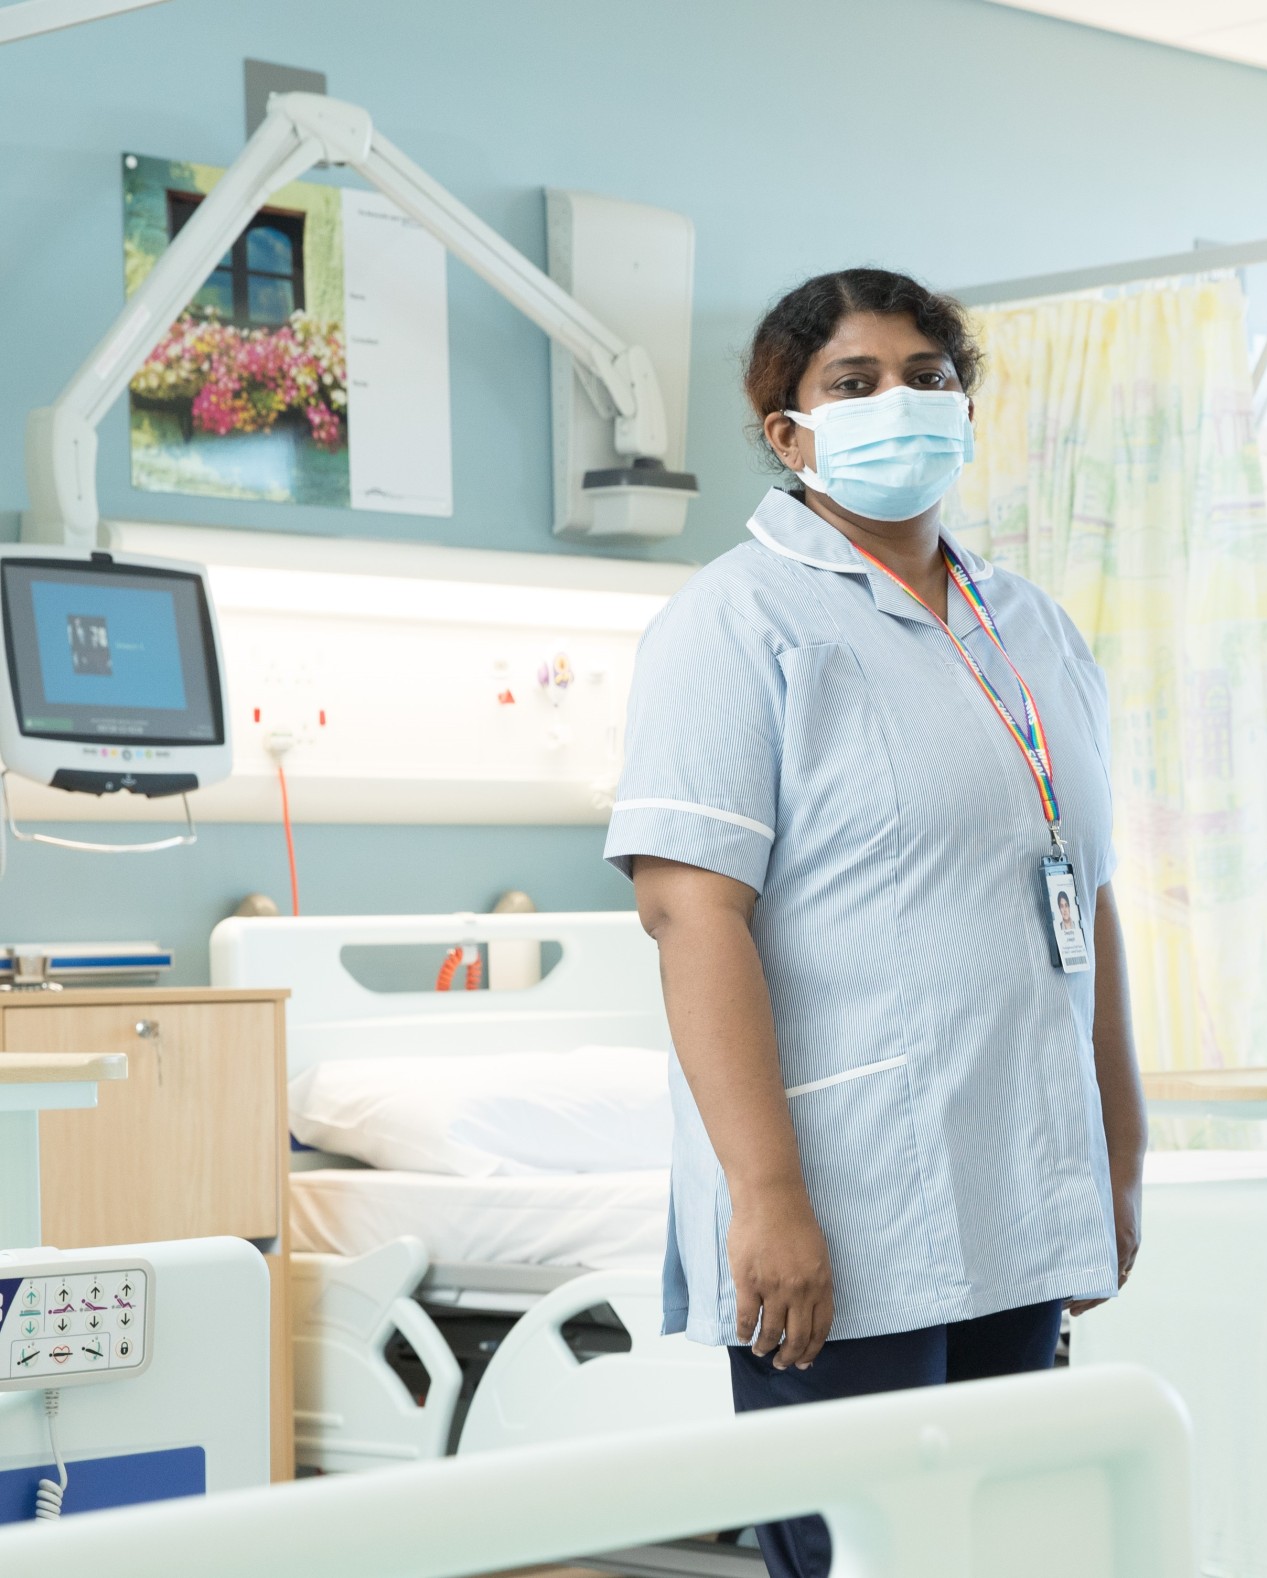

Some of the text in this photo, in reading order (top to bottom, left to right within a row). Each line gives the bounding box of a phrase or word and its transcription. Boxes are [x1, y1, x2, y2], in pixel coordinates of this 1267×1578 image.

[951, 564, 971, 586] NHS
[974, 605, 995, 629] NHS
[997, 700, 1017, 725] NHS
[1025, 701, 1038, 725] NHS
[1028, 749, 1046, 776] NHS
[1034, 748, 1051, 777] NH
